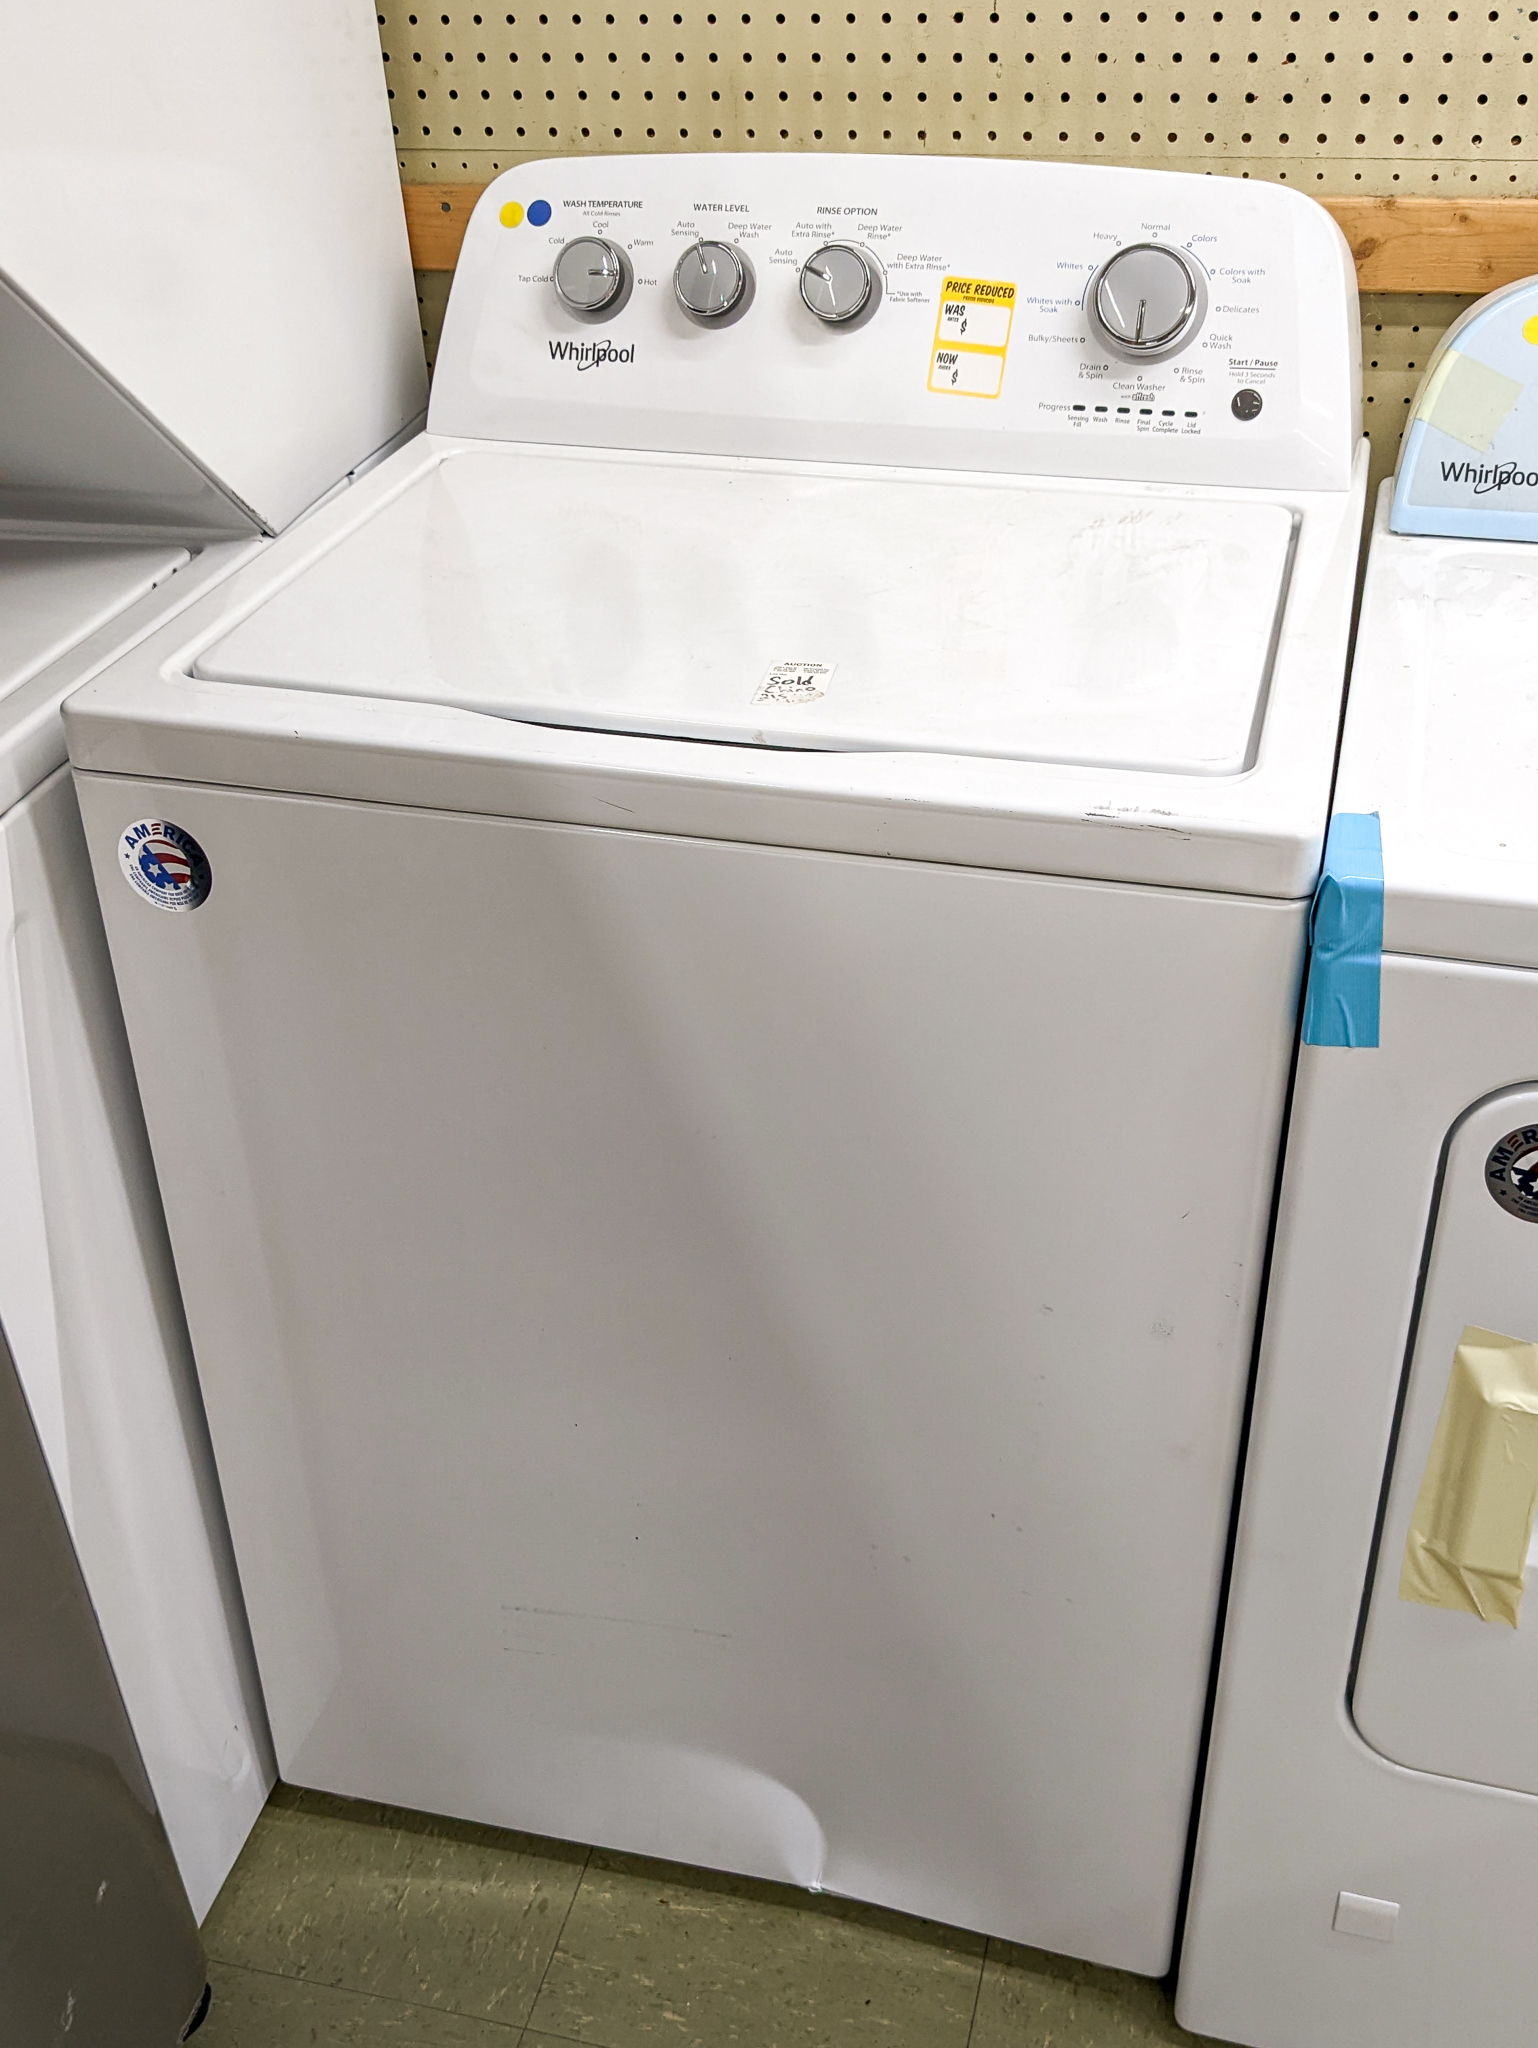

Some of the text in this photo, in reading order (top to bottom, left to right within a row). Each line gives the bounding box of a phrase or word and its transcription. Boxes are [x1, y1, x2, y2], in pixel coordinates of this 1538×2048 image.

[563, 200, 643, 209] WASH TEMPERATURE
[693, 203, 750, 213] WATER LEVEL
[816, 206, 878, 216] RINSE OPTION
[728, 222, 772, 231] Deep Water
[815, 222, 832, 230] with
[857, 224, 902, 233] Deep Water
[1141, 223, 1171, 231] Normal
[671, 229, 699, 238] Sensing
[791, 230, 810, 238] Extra
[1093, 232, 1118, 241] Heavy
[633, 239, 654, 247] Warm
[769, 256, 798, 266] Sensing
[897, 253, 942, 262] Deep Water
[1056, 262, 1083, 270] Whites
[1219, 268, 1266, 276] Colors with
[518, 275, 549, 284] Tap Cold
[1231, 276, 1251, 284] Soak
[945, 281, 1015, 299] PRICE REDUCED
[1027, 297, 1073, 306] Whites with
[944, 303, 966, 317] WAS
[1222, 305, 1260, 314] Delicates
[960, 318, 968, 335] $
[1028, 334, 1079, 344] Bulky/Sheets
[1209, 333, 1233, 342] Quick
[1209, 342, 1232, 350] Wash
[549, 340, 635, 371] Whirlpool
[936, 352, 959, 365] NOW
[1079, 363, 1102, 371] Drain
[1228, 358, 1248, 366] Start
[1254, 359, 1279, 367] Pause
[1077, 371, 1103, 380] & Spin
[1181, 367, 1203, 375] Rinse
[951, 369, 958, 386] $
[1179, 375, 1206, 385] & Spin
[1112, 382, 1166, 391] Clean Washer
[1038, 402, 1071, 412] Progress
[1067, 414, 1090, 423] Sensing
[1152, 426, 1179, 434] Complete
[1441, 462, 1538, 494] Whirlpoo
[767, 675, 814, 686] Sold
[124, 822, 204, 867] AMERICA
[1489, 1128, 1538, 1182] AMER
